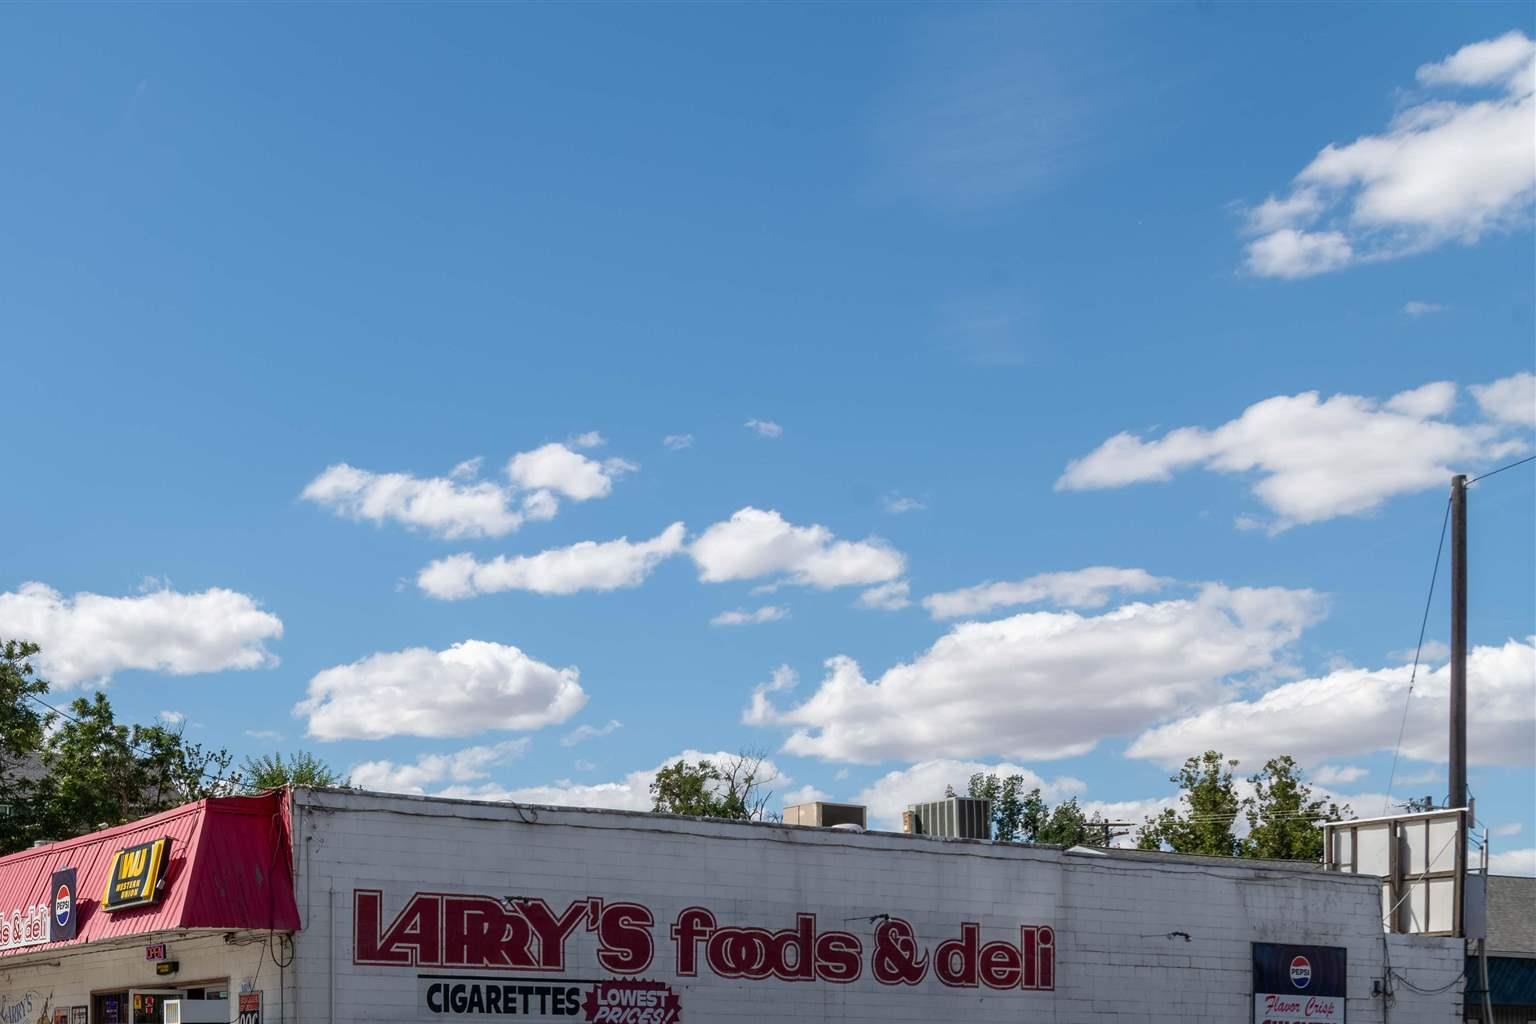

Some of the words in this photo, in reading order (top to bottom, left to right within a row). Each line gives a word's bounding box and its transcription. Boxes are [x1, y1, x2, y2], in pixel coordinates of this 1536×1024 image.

[57, 900, 70, 911] PEPSI
[13, 910, 22, 943] &
[25, 906, 49, 941] deli
[352, 888, 654, 973] LARRY'S
[671, 905, 862, 982] foods
[871, 919, 930, 986] &
[933, 921, 1056, 992] deli
[1291, 968, 1310, 976] PEPSI
[427, 983, 580, 1016] CIGARETTES
[597, 988, 668, 1007] LOWEST
[1265, 995, 1300, 1014] Flavor
[1305, 997, 1335, 1017] Crisp
